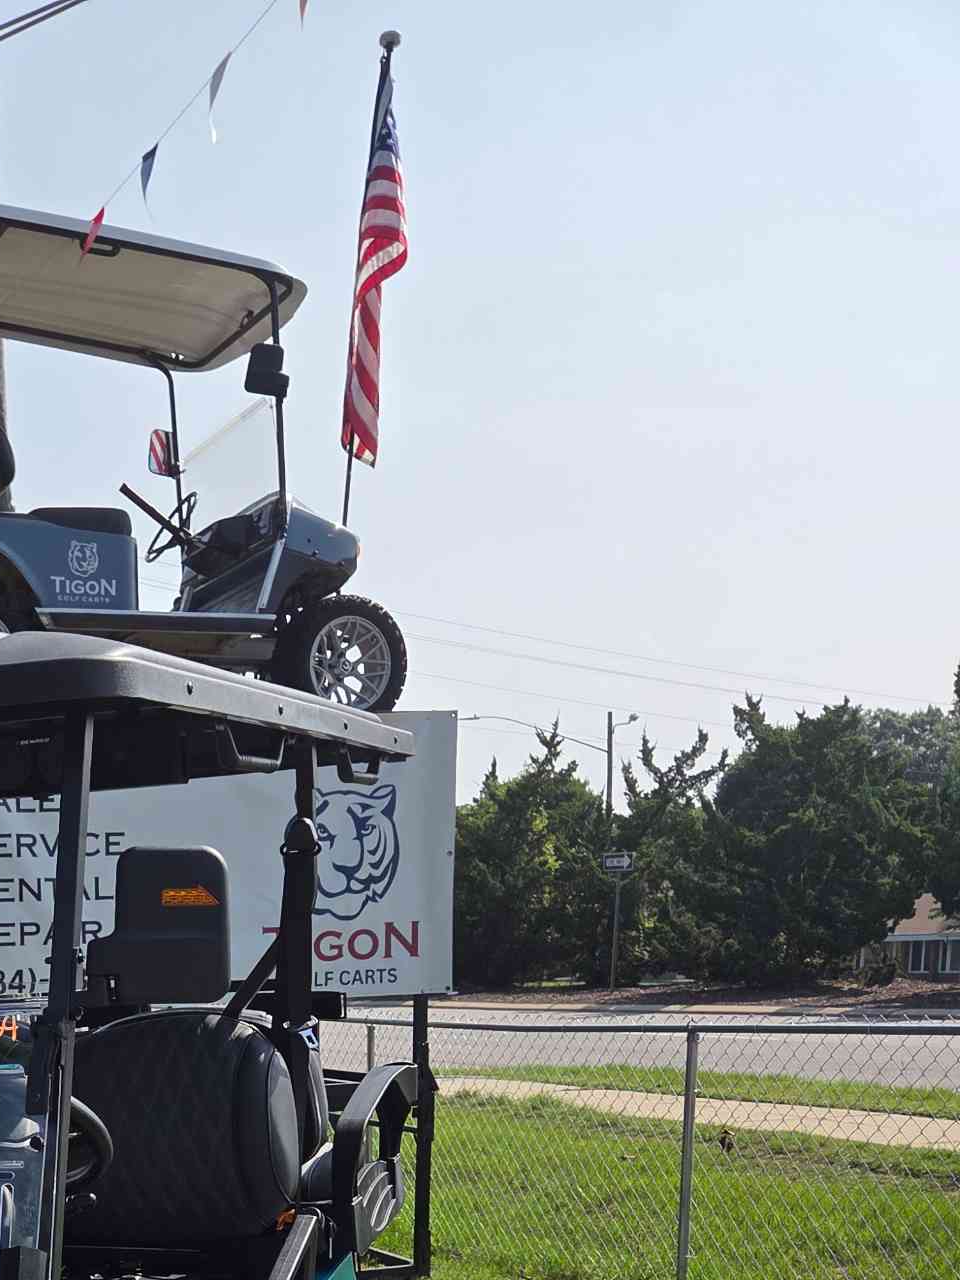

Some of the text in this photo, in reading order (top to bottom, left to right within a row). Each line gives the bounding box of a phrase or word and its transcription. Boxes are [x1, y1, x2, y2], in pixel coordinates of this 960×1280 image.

[50, 576, 117, 595] TIGON
[262, 920, 420, 962] GON
[314, 968, 398, 987] LF CARTS
